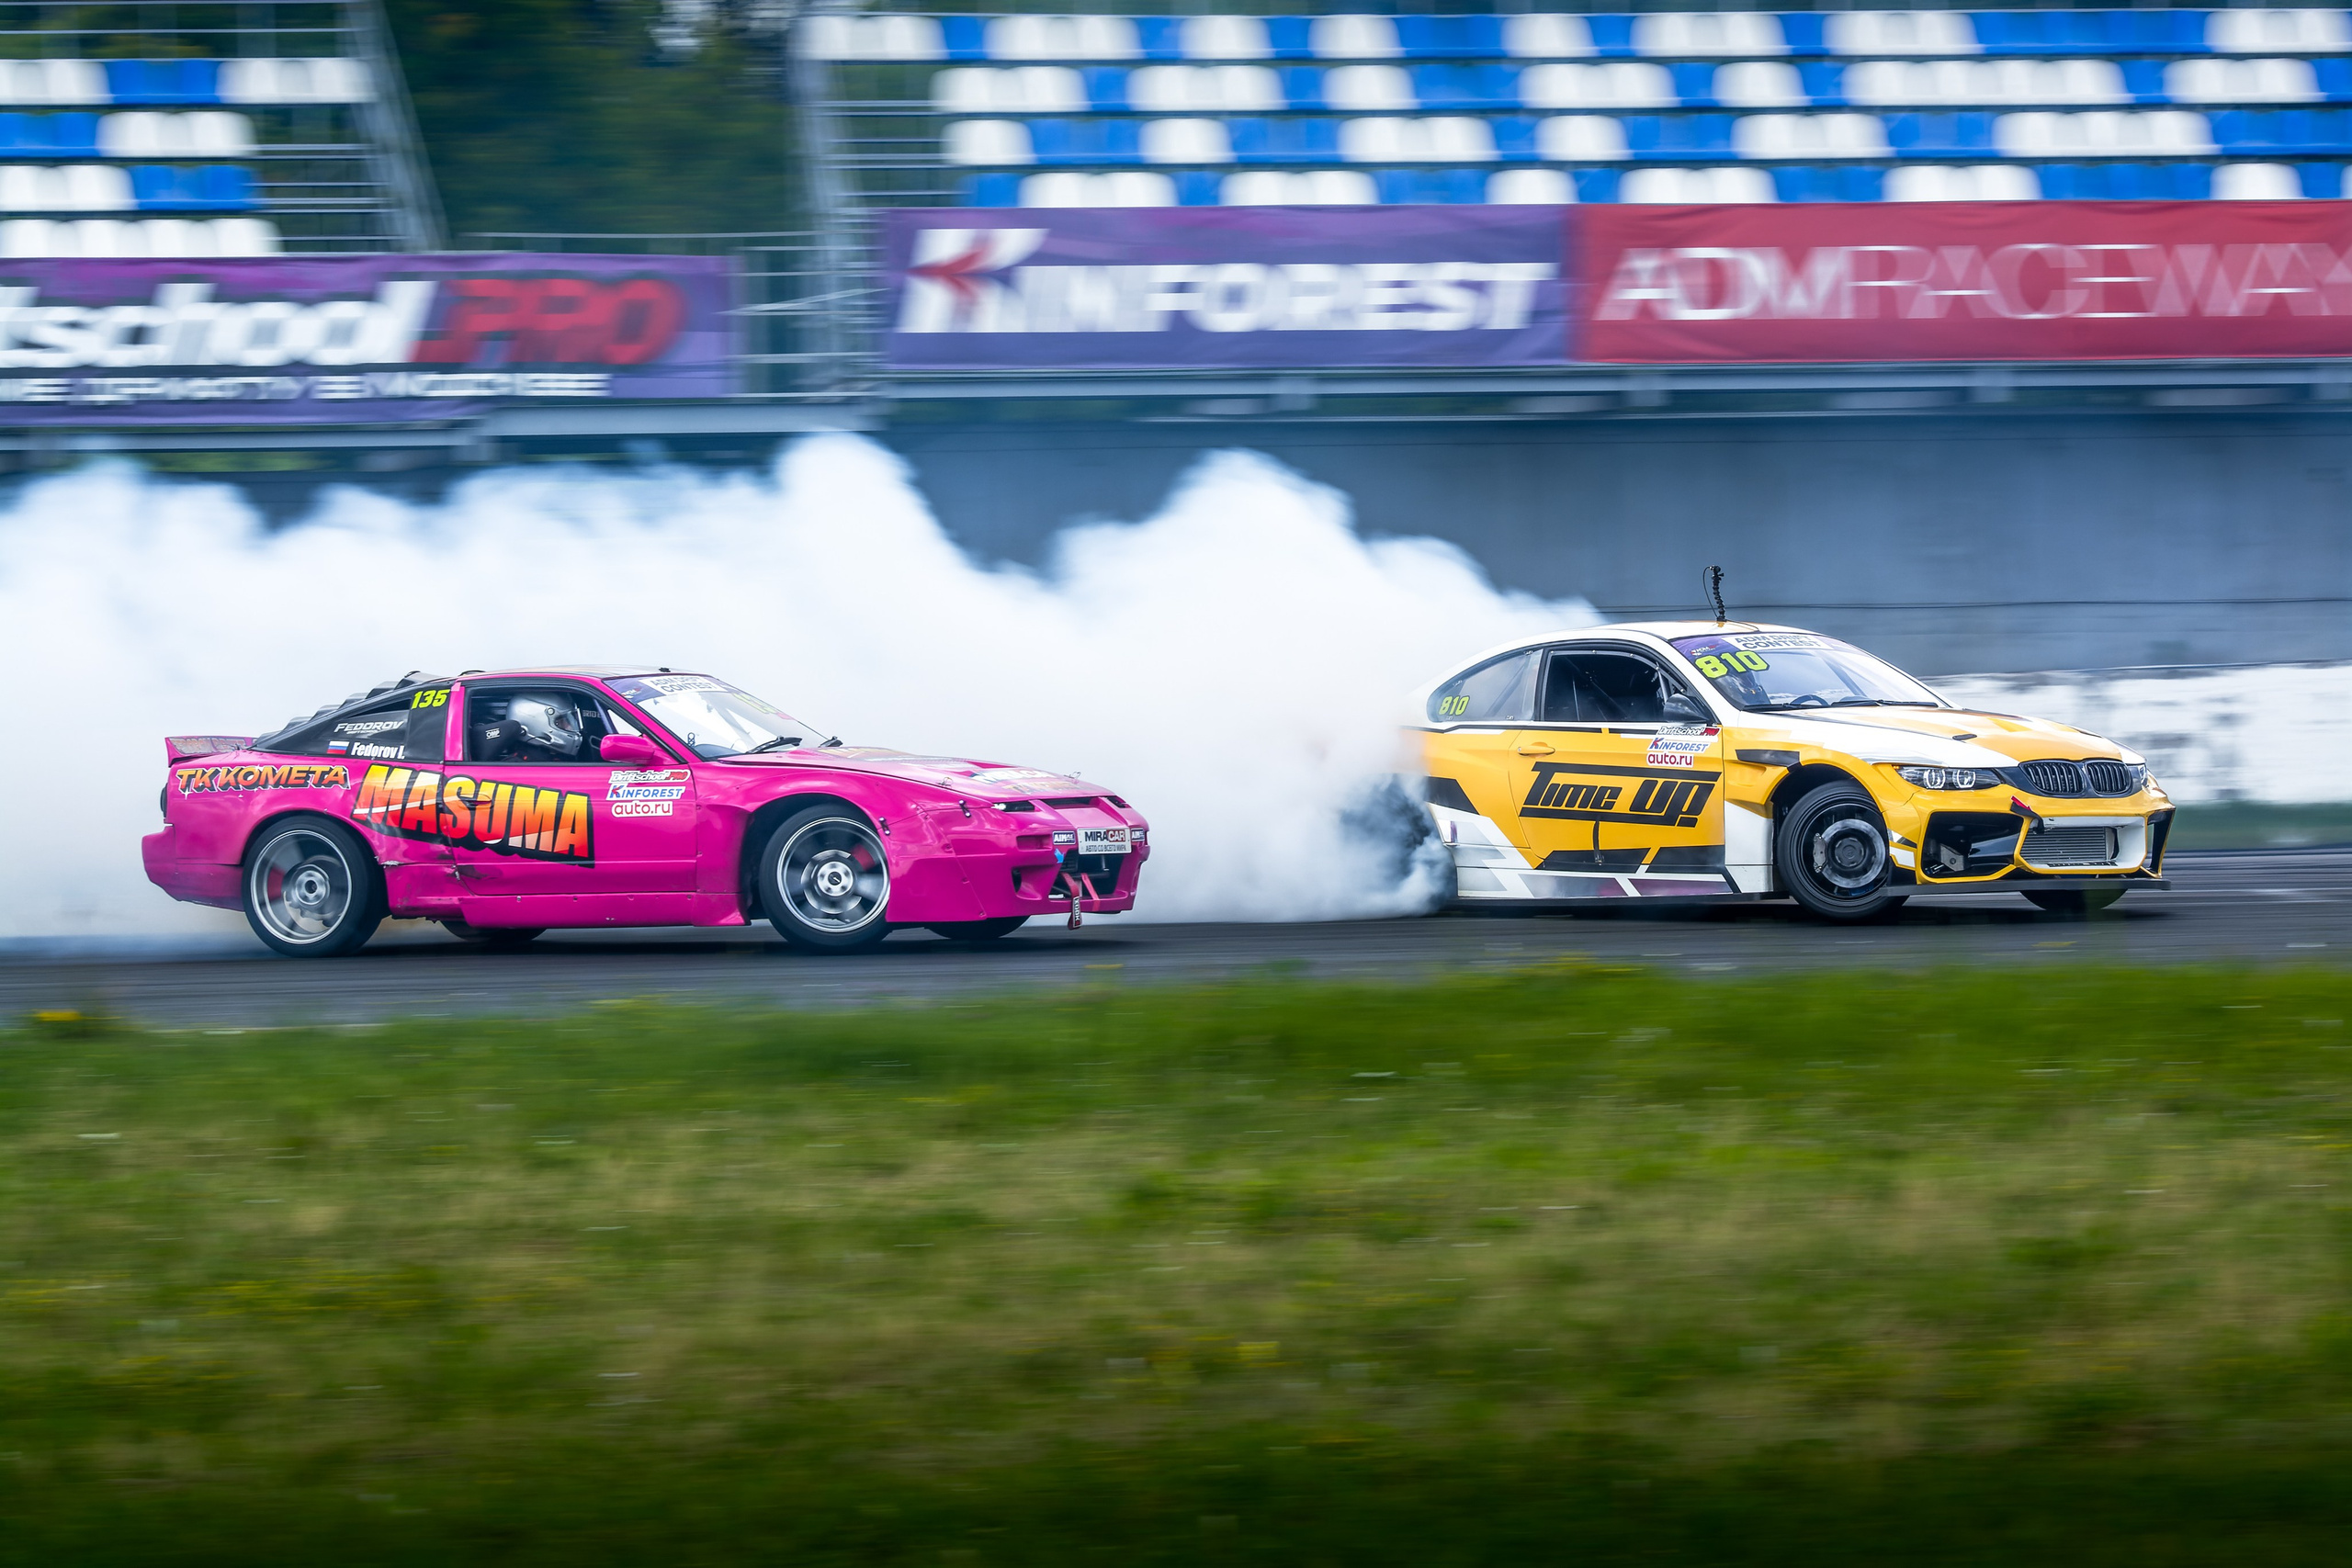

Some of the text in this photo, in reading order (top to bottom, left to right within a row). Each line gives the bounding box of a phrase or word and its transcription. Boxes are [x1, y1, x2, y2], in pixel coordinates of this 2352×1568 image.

[895, 228, 1559, 333] KINFOREST
[1742, 640, 1821, 649] CONTEST
[1695, 650, 1770, 679] 810
[411, 689, 450, 709] 135
[1438, 695, 1470, 716] 810
[334, 720, 404, 733] FEDOROV
[351, 742, 398, 759] Fedorov
[1649, 738, 1709, 751] KINFOREST
[1648, 753, 1692, 765] auto.ru
[609, 784, 683, 798] KINFOREST
[351, 764, 592, 863] MASUMA
[614, 802, 671, 816] auto.ru
